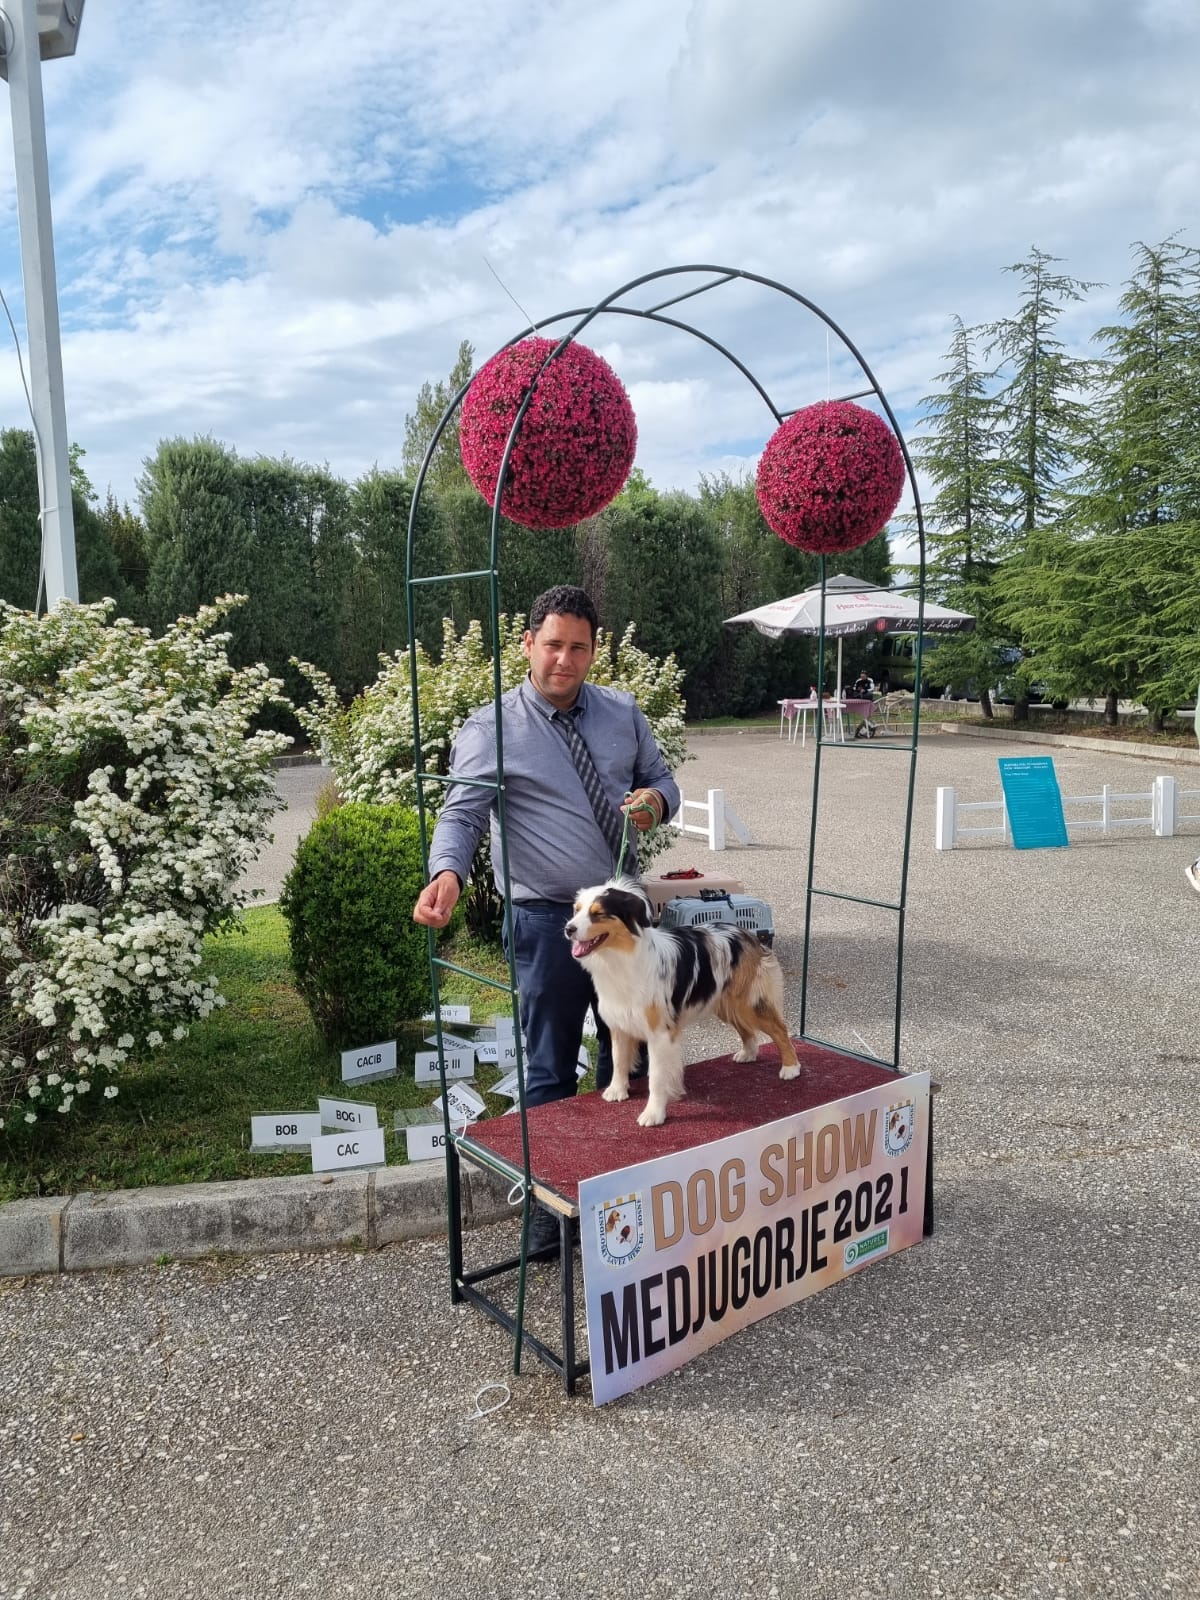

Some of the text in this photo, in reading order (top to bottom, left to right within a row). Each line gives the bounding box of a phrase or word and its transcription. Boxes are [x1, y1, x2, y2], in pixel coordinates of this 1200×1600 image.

[357, 1054, 381, 1067] CACIB
[429, 1059, 461, 1072] BOG III
[335, 1109, 361, 1124] BOG I
[275, 1124, 298, 1136] BOB
[432, 1135, 446, 1148] BO
[336, 1142, 360, 1157] CAC
[651, 1157, 746, 1252] DOG
[759, 1109, 878, 1207] SHOW
[600, 1166, 909, 1375] MEDJUGORJE 2021
